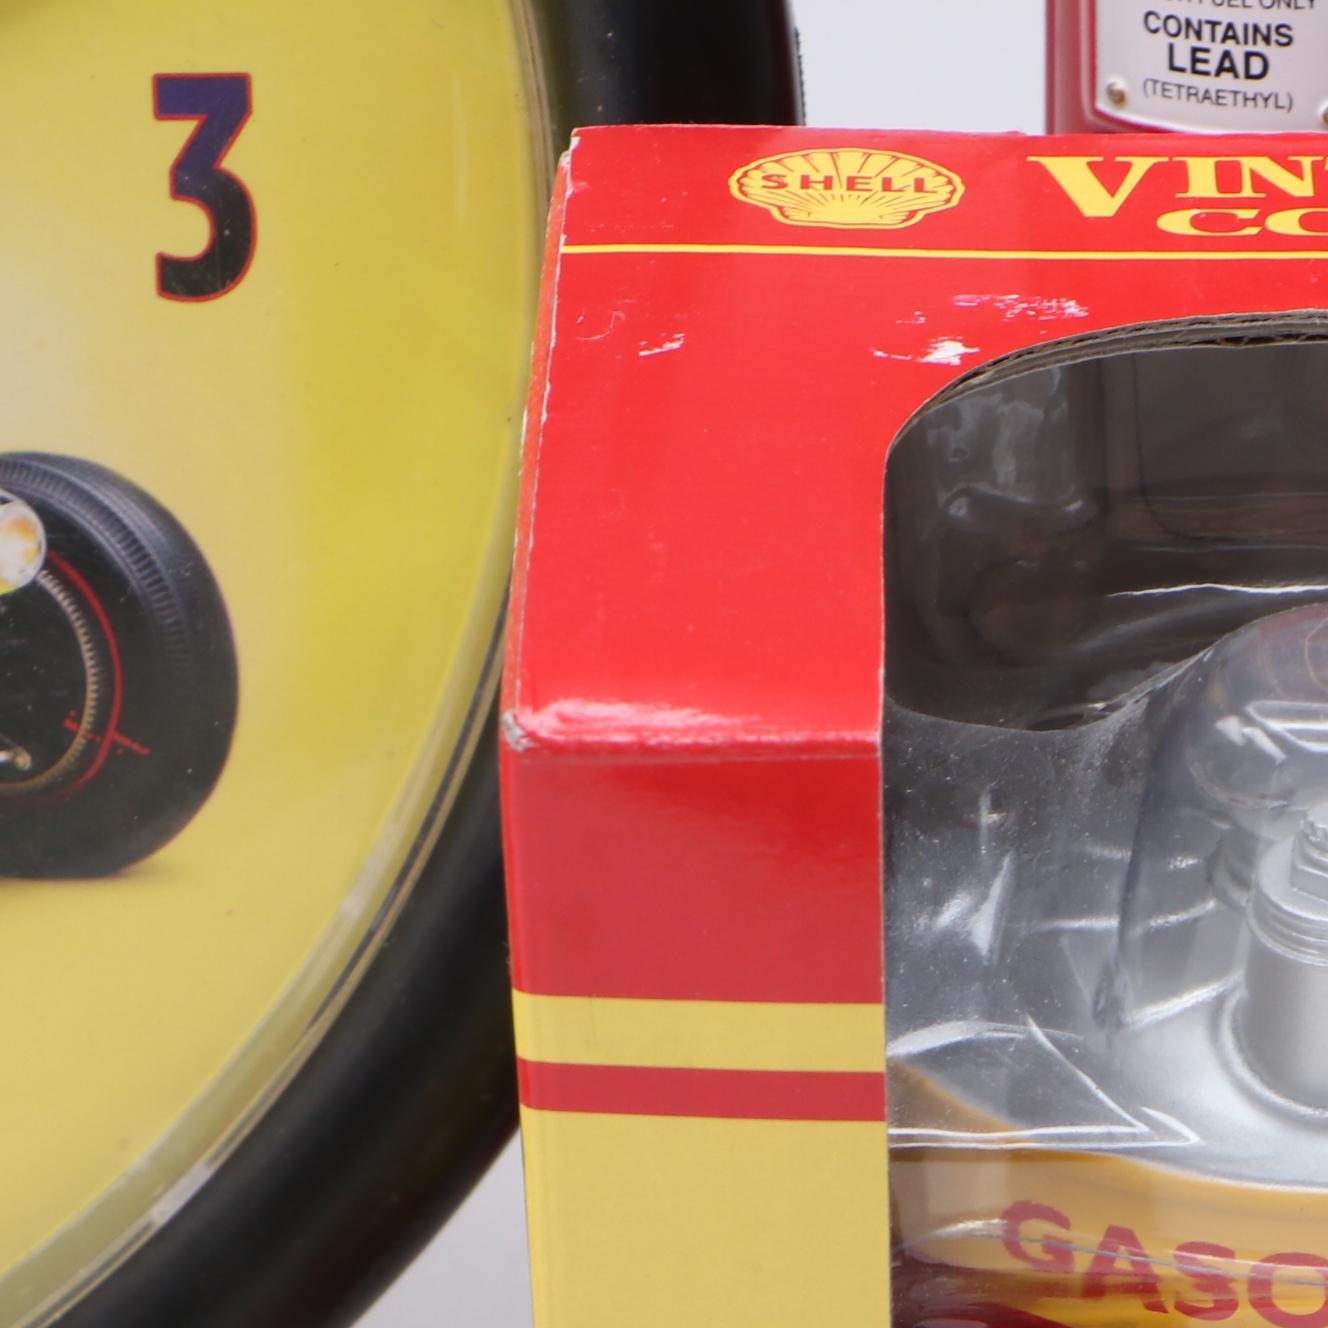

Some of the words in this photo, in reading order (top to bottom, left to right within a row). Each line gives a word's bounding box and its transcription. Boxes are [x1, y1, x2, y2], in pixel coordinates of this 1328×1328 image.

[1143, 11, 1294, 47] CONTAINS
[1168, 43, 1270, 81] LEAD
[1143, 78, 1294, 113] (TETRAETHYL)
[152, 72, 258, 303] 3
[760, 173, 932, 195] SHELL
